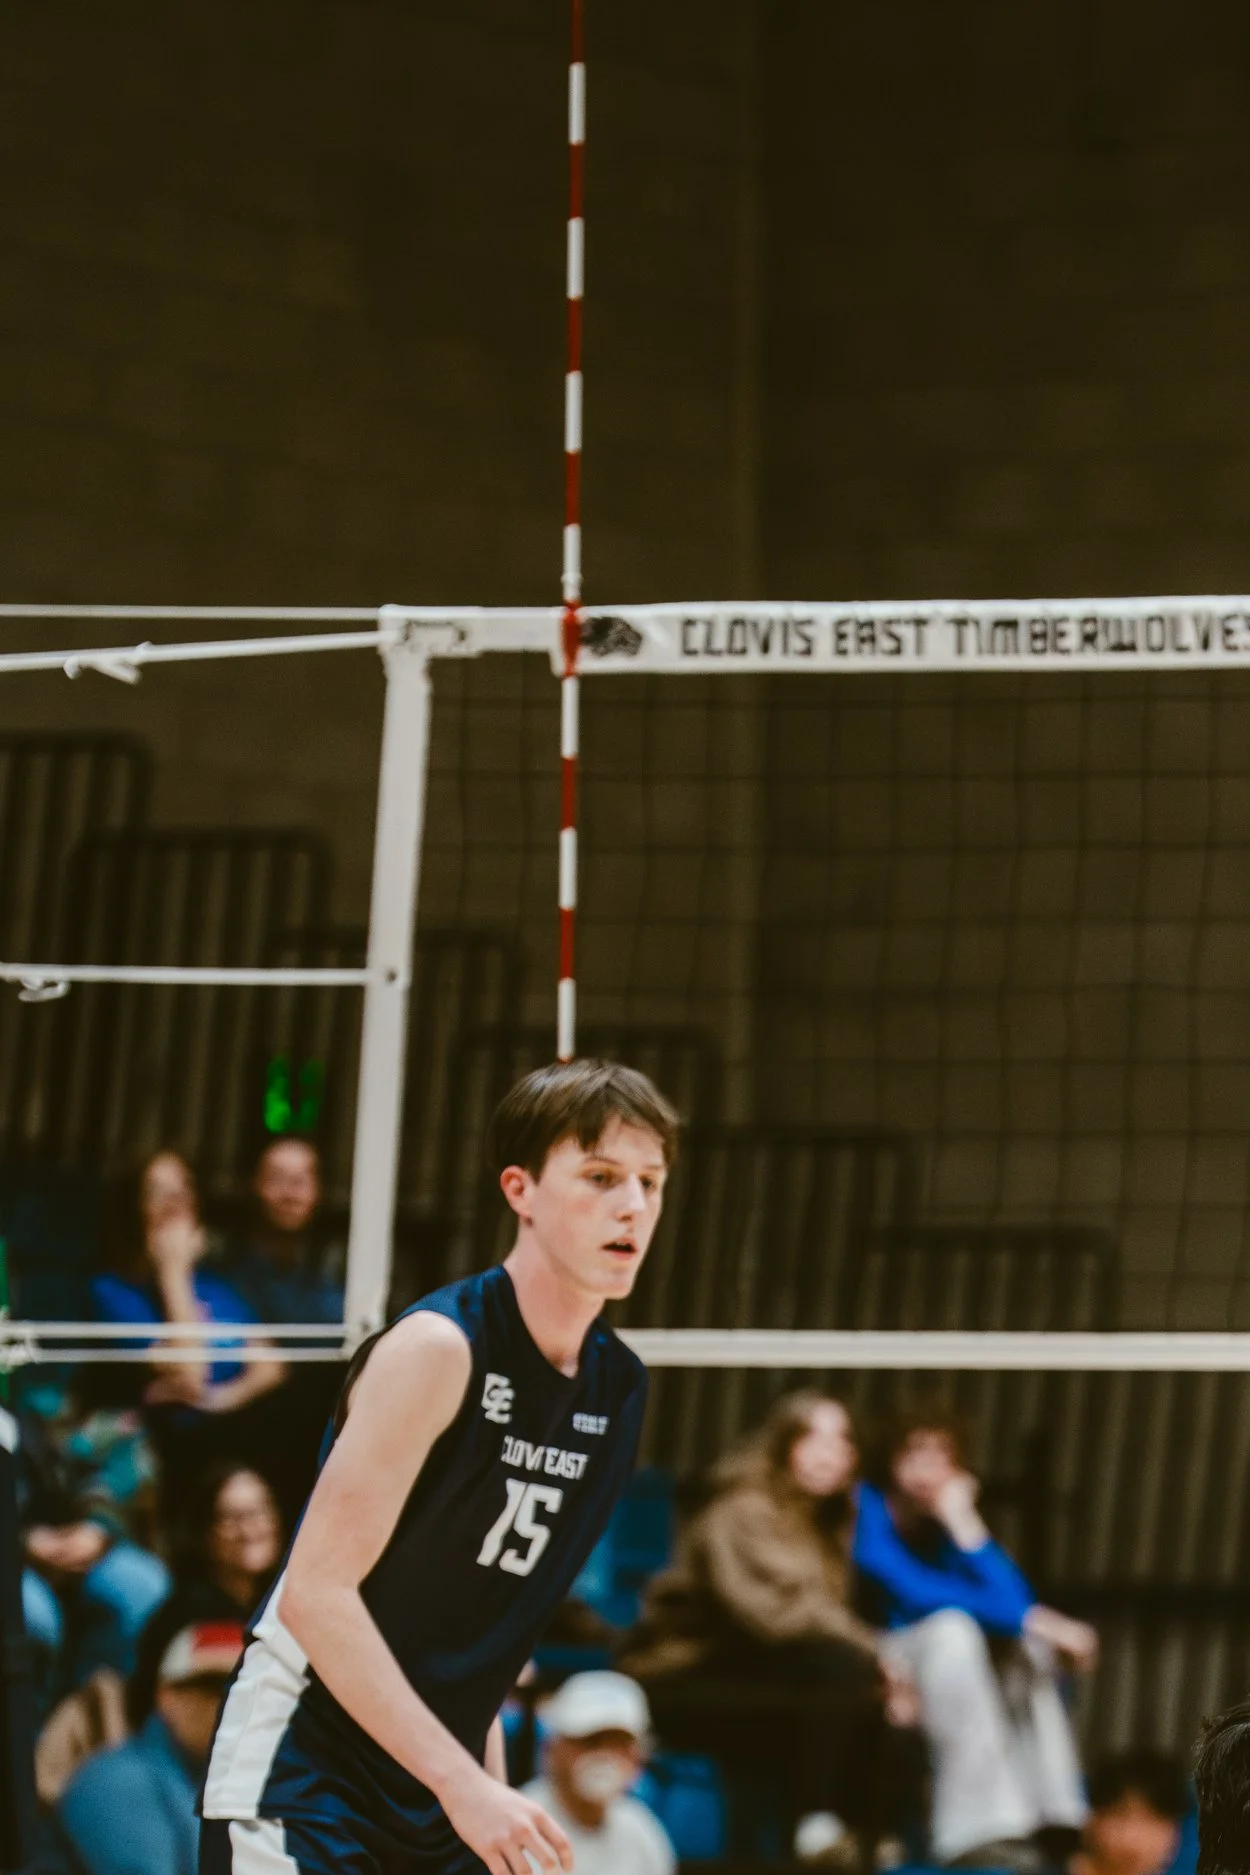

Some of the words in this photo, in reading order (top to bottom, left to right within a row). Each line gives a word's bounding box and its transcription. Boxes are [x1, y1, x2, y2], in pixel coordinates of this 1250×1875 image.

[680, 617, 814, 657] CLOVIS
[832, 616, 928, 656] EAST
[544, 1446, 590, 1480] EAST
[476, 1477, 563, 1578] 15
